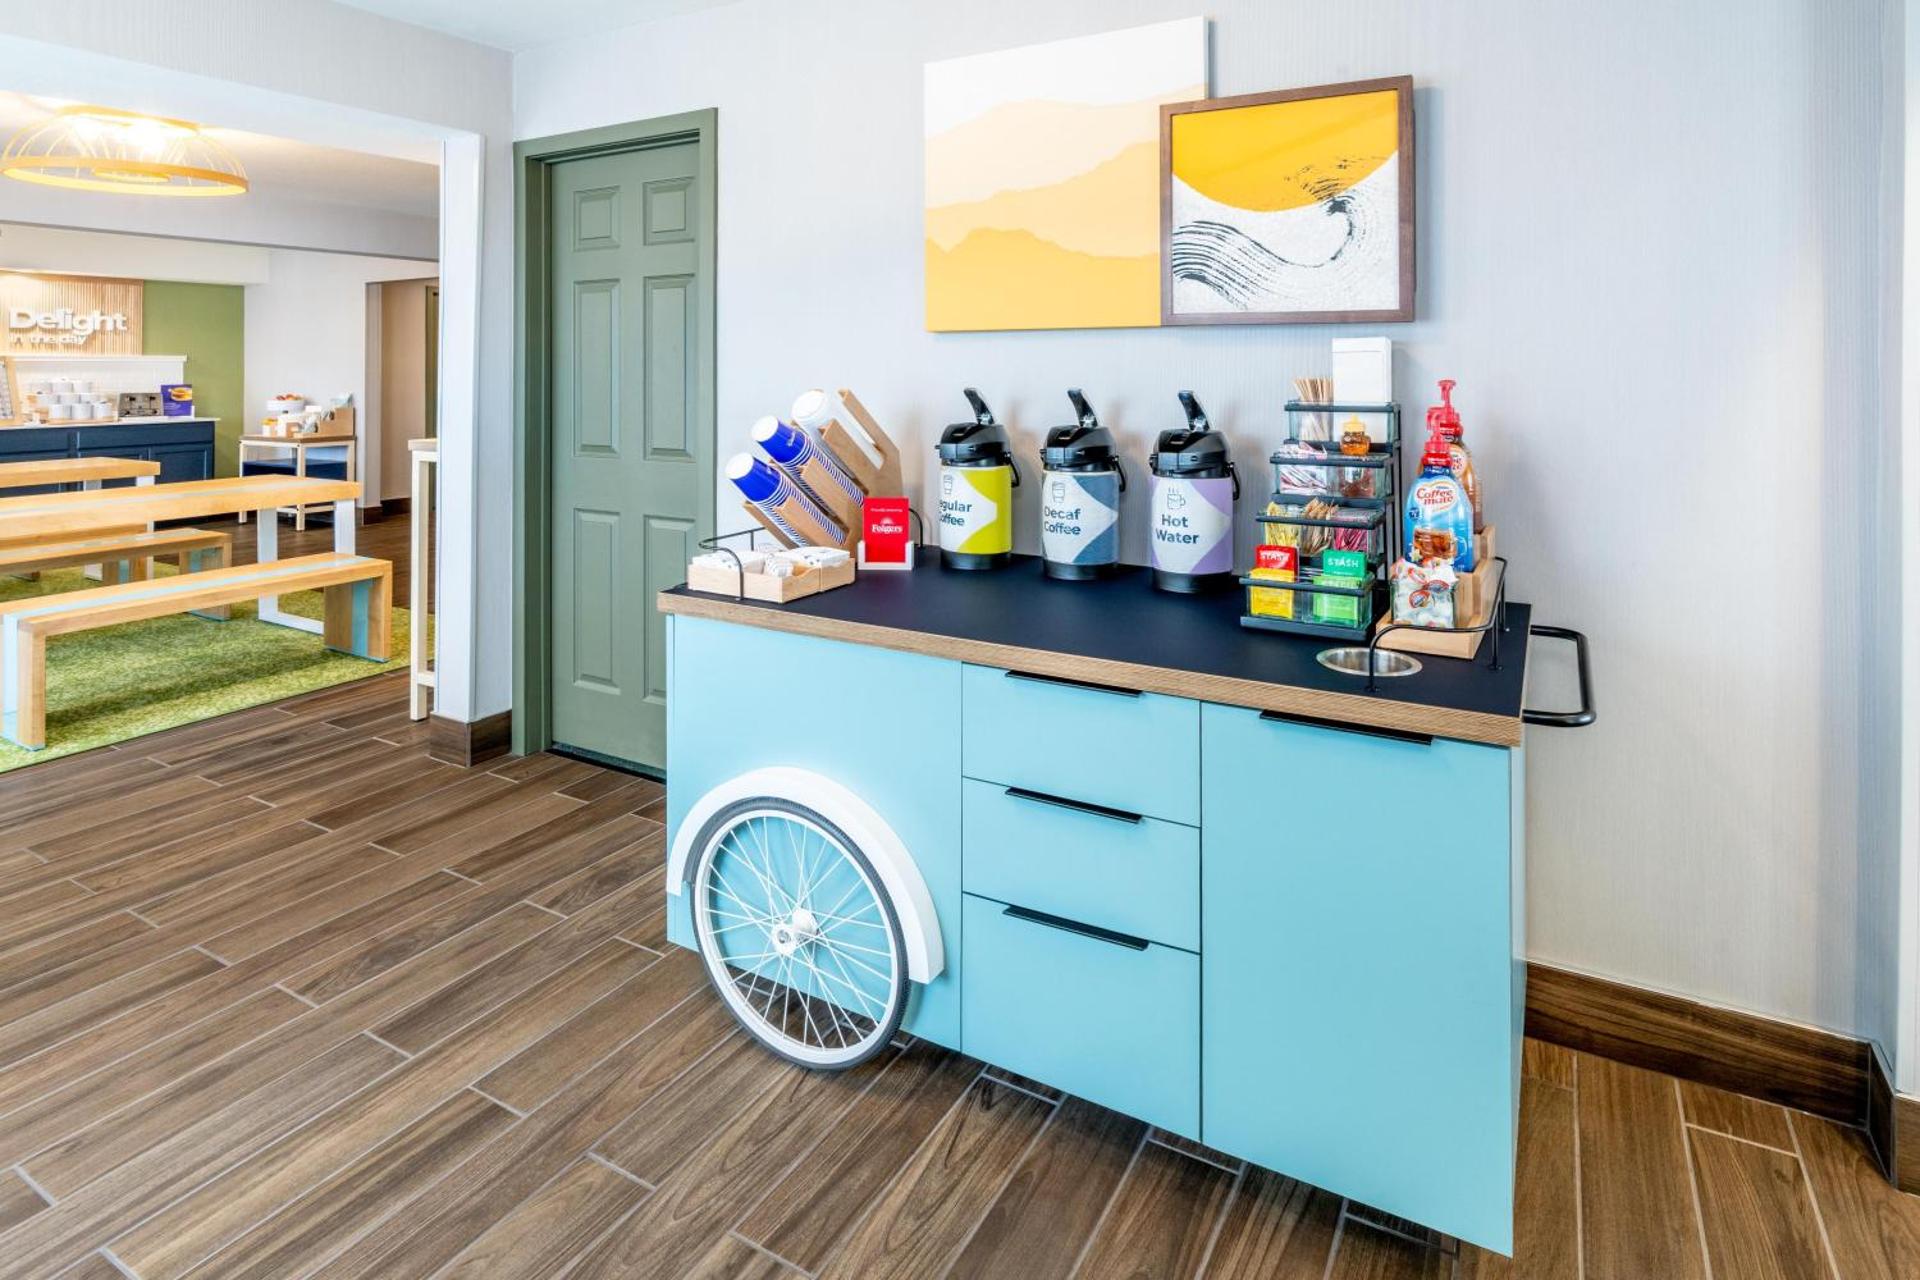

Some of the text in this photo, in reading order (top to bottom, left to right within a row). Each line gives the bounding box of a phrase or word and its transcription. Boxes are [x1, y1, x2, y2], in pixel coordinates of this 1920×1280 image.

[9, 305, 127, 336] Delight
[1416, 487, 1453, 499] Coffee
[1423, 495, 1454, 505] mate
[938, 499, 973, 512] egular
[1044, 505, 1081, 520] Decaf
[1044, 520, 1081, 535] Coffee
[1161, 513, 1189, 528] Hot
[1155, 528, 1200, 544] Water
[1327, 556, 1360, 568] STASH
